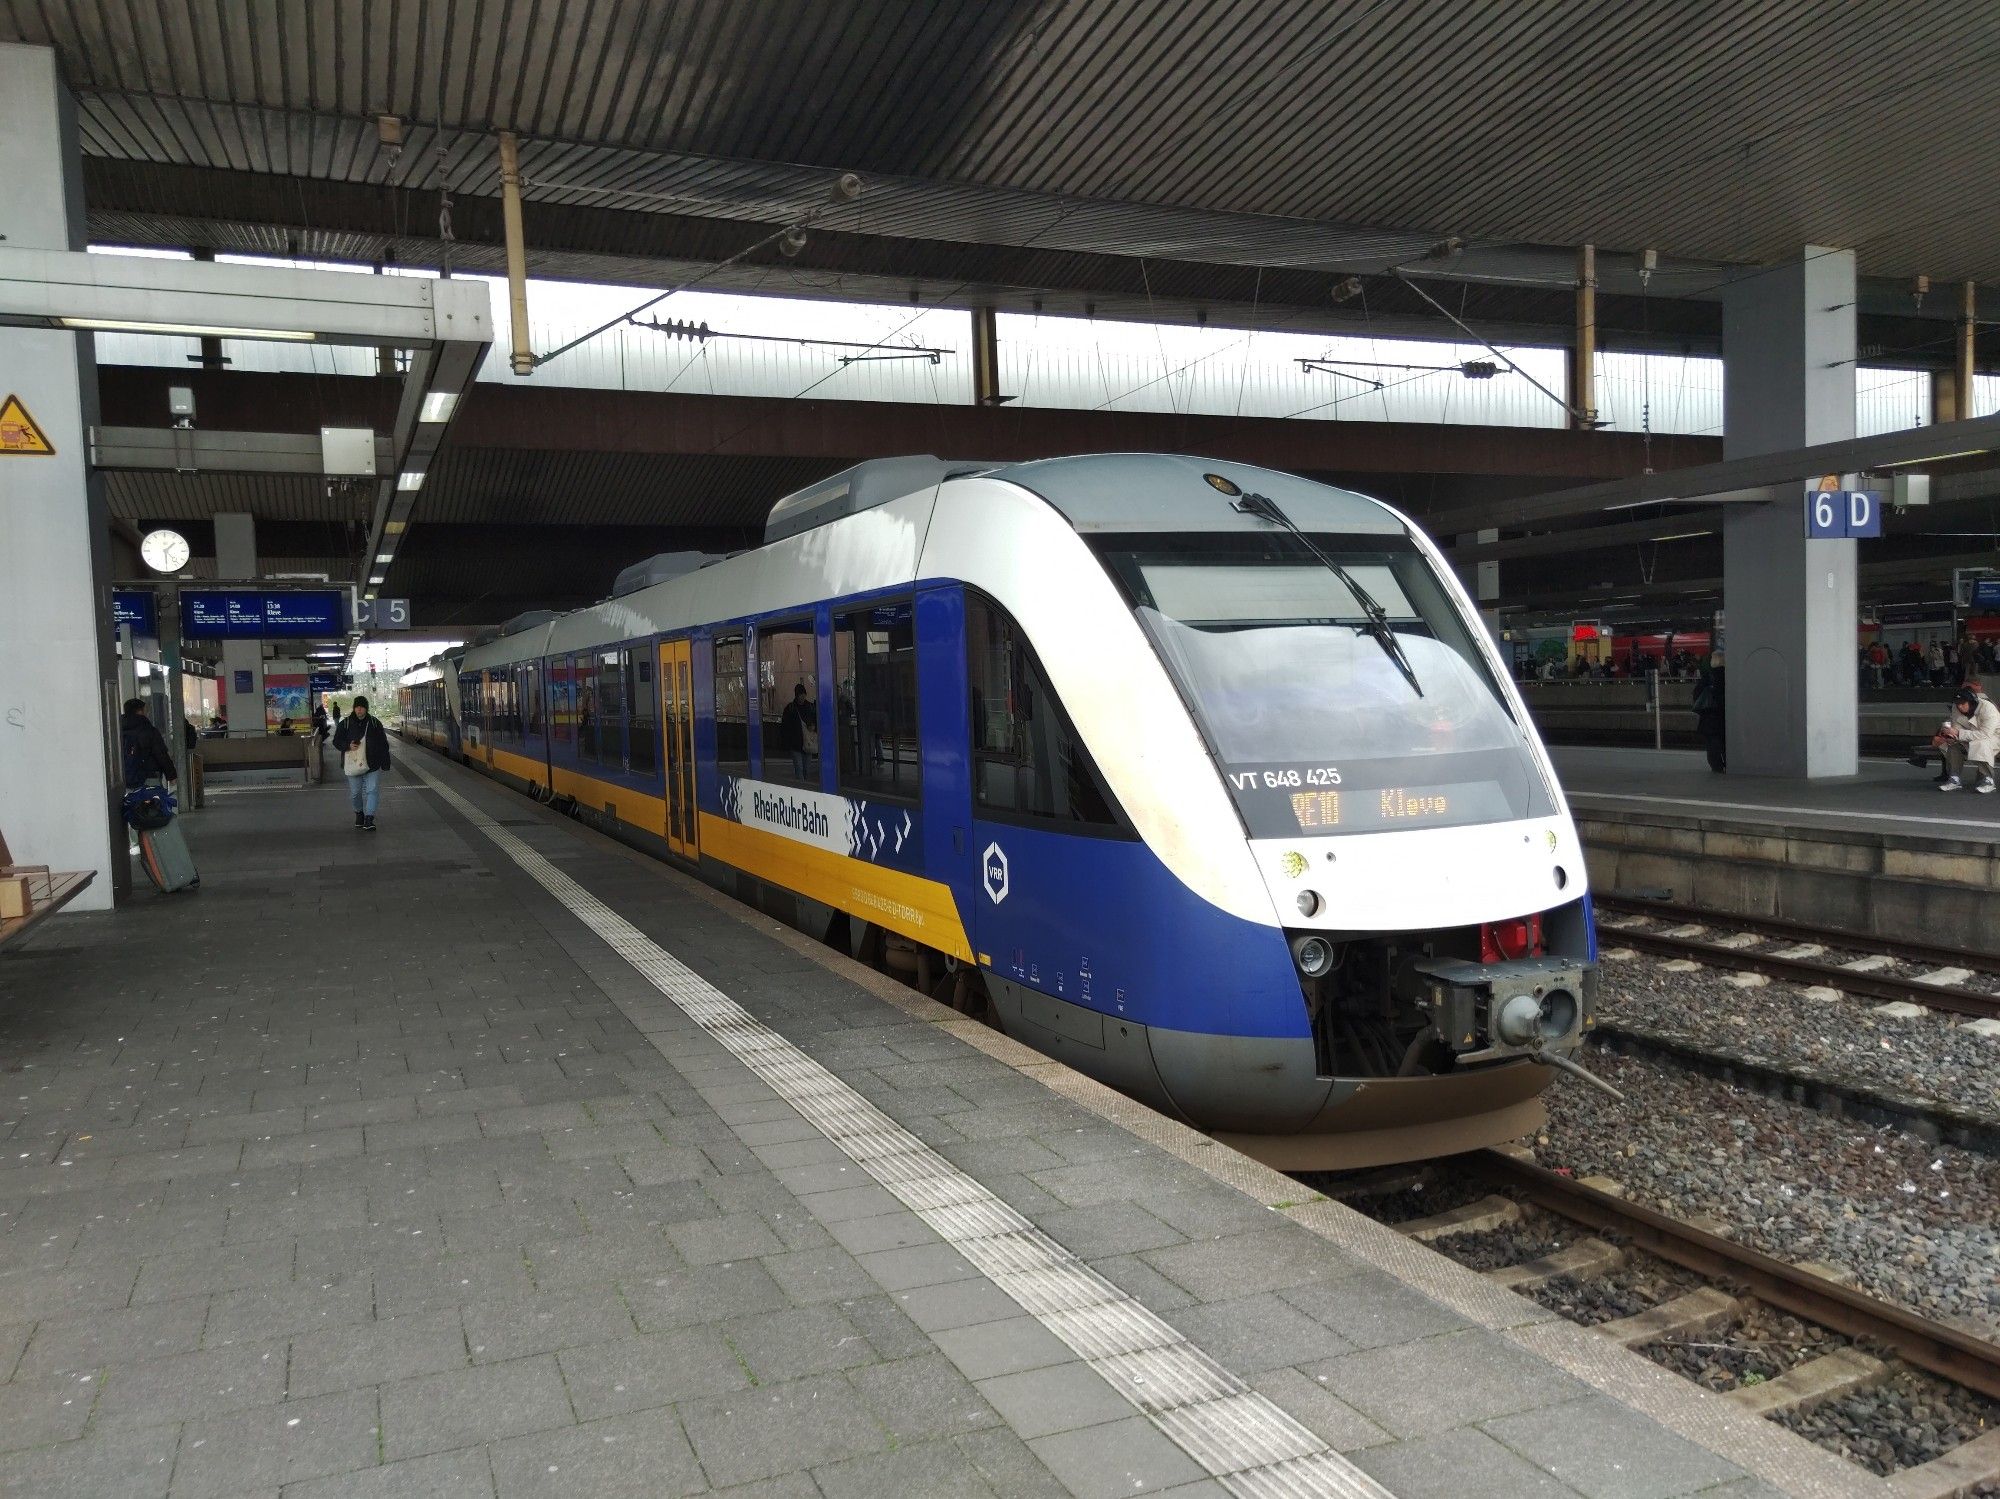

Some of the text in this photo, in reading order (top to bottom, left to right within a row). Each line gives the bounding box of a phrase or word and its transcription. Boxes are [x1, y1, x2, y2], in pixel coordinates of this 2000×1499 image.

[1815, 492, 1870, 528] 6 D
[351, 600, 406, 623] C 5
[747, 625, 755, 659] 2
[1229, 767, 1342, 791] VT 648 425
[753, 789, 830, 838] RheinRuhrBahn
[1380, 788, 1447, 818] Kleve
[988, 865, 1003, 881] VRR
